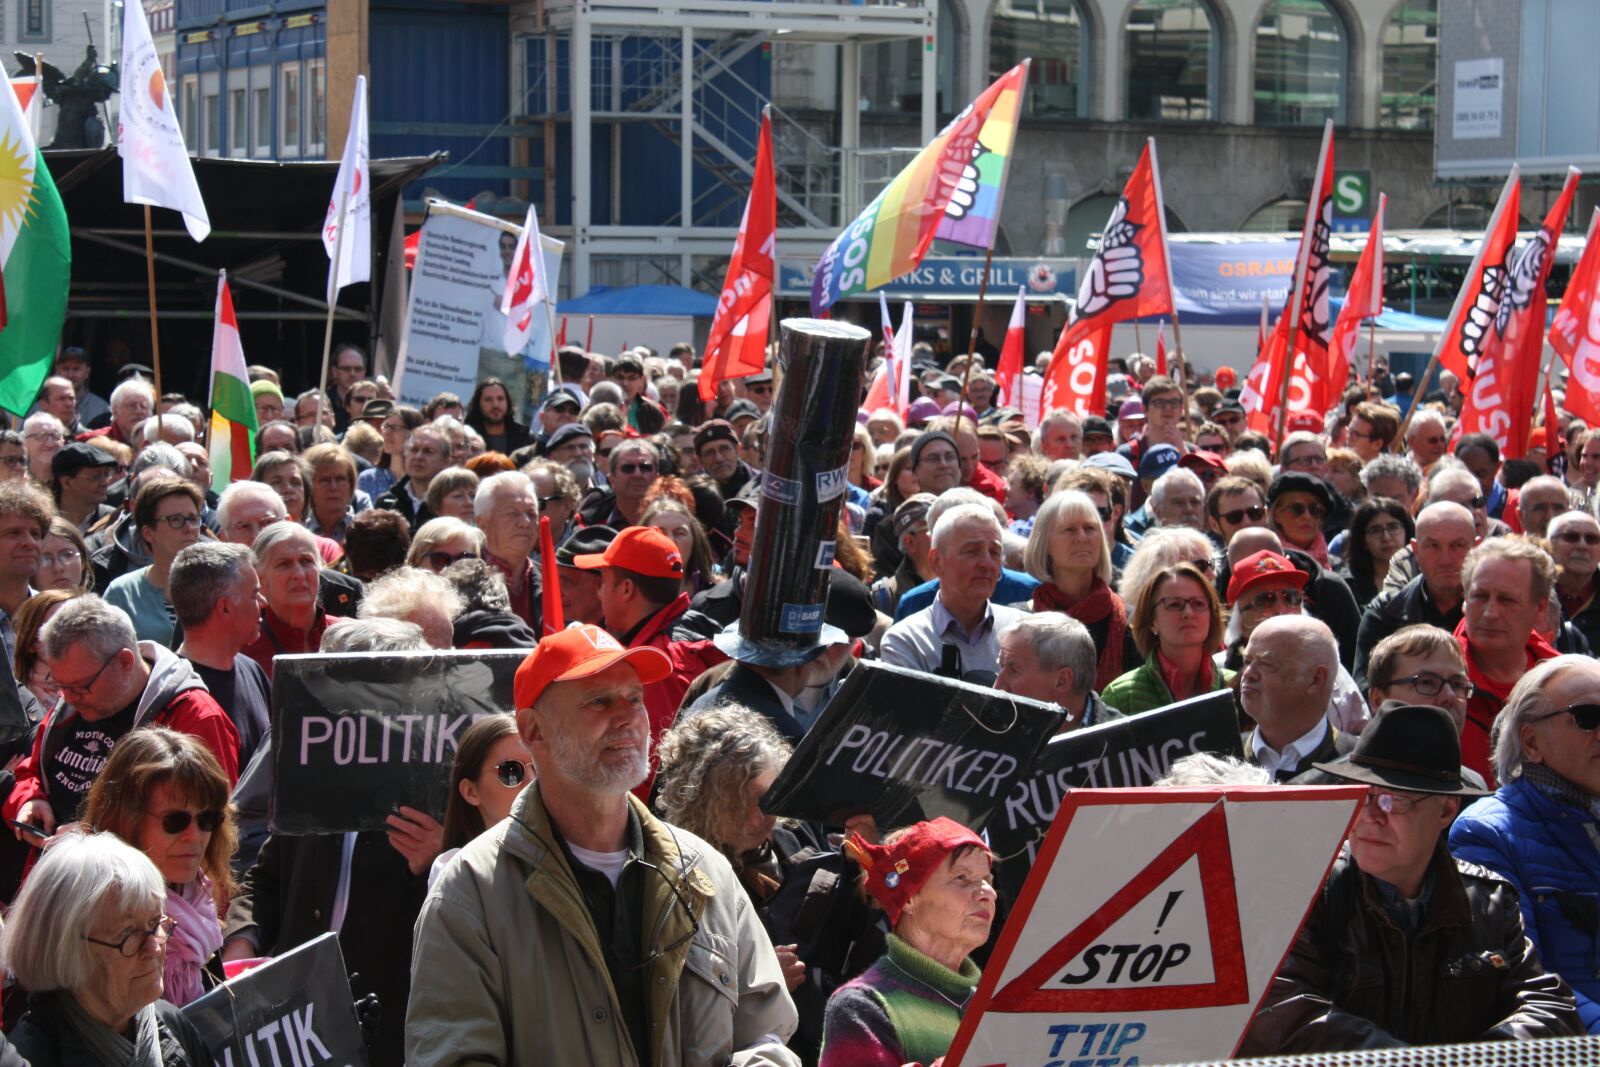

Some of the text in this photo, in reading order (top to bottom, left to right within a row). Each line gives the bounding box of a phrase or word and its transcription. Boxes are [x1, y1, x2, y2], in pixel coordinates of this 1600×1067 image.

[1337, 175, 1362, 213] S
[939, 267, 956, 286] &
[1219, 260, 1295, 277] OSRAM
[1238, 288, 1257, 300] wir
[818, 467, 847, 488] RW
[299, 713, 490, 765] POLITIK
[826, 724, 1015, 797] POLITIKER
[55, 771, 92, 792] ENGLND
[1059, 943, 1191, 984] STOP
[1047, 1023, 1147, 1058] TTIP
